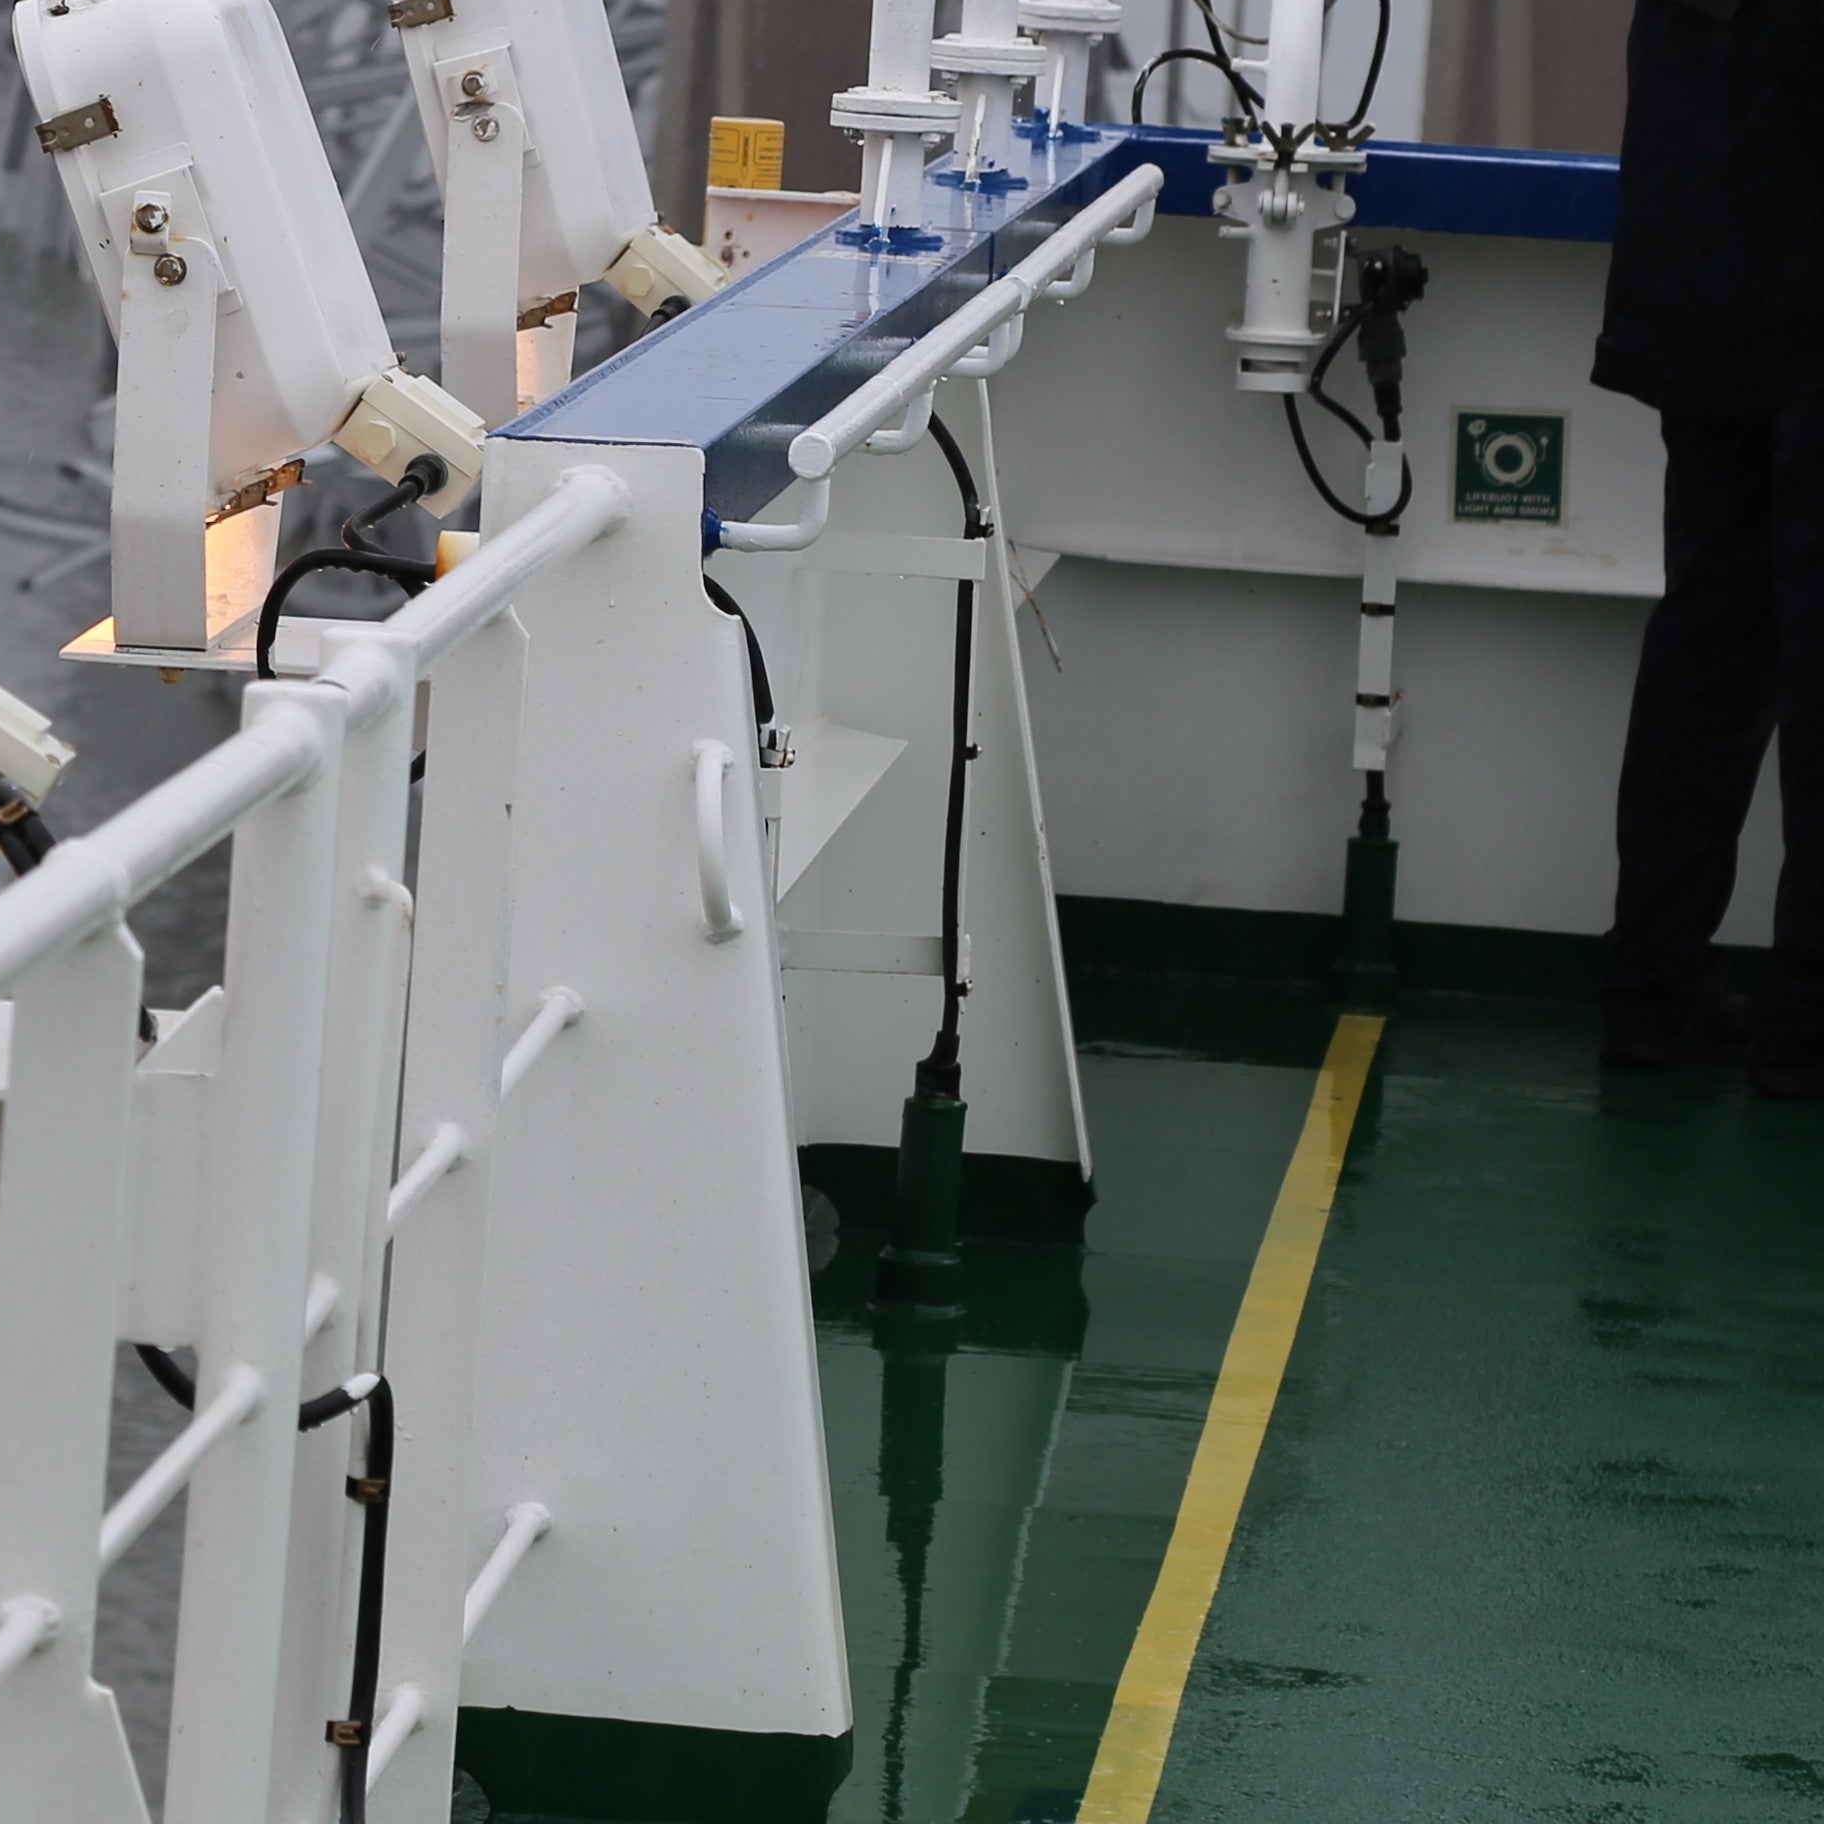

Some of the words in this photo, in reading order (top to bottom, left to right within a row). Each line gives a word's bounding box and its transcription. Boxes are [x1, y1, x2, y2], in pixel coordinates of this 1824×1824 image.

[1466, 491, 1518, 502] LIFEBUOY
[1522, 494, 1551, 504] WITH
[1458, 503, 1489, 513] LIGHT
[1494, 505, 1517, 515] AND
[1519, 506, 1556, 516] SMOKE
